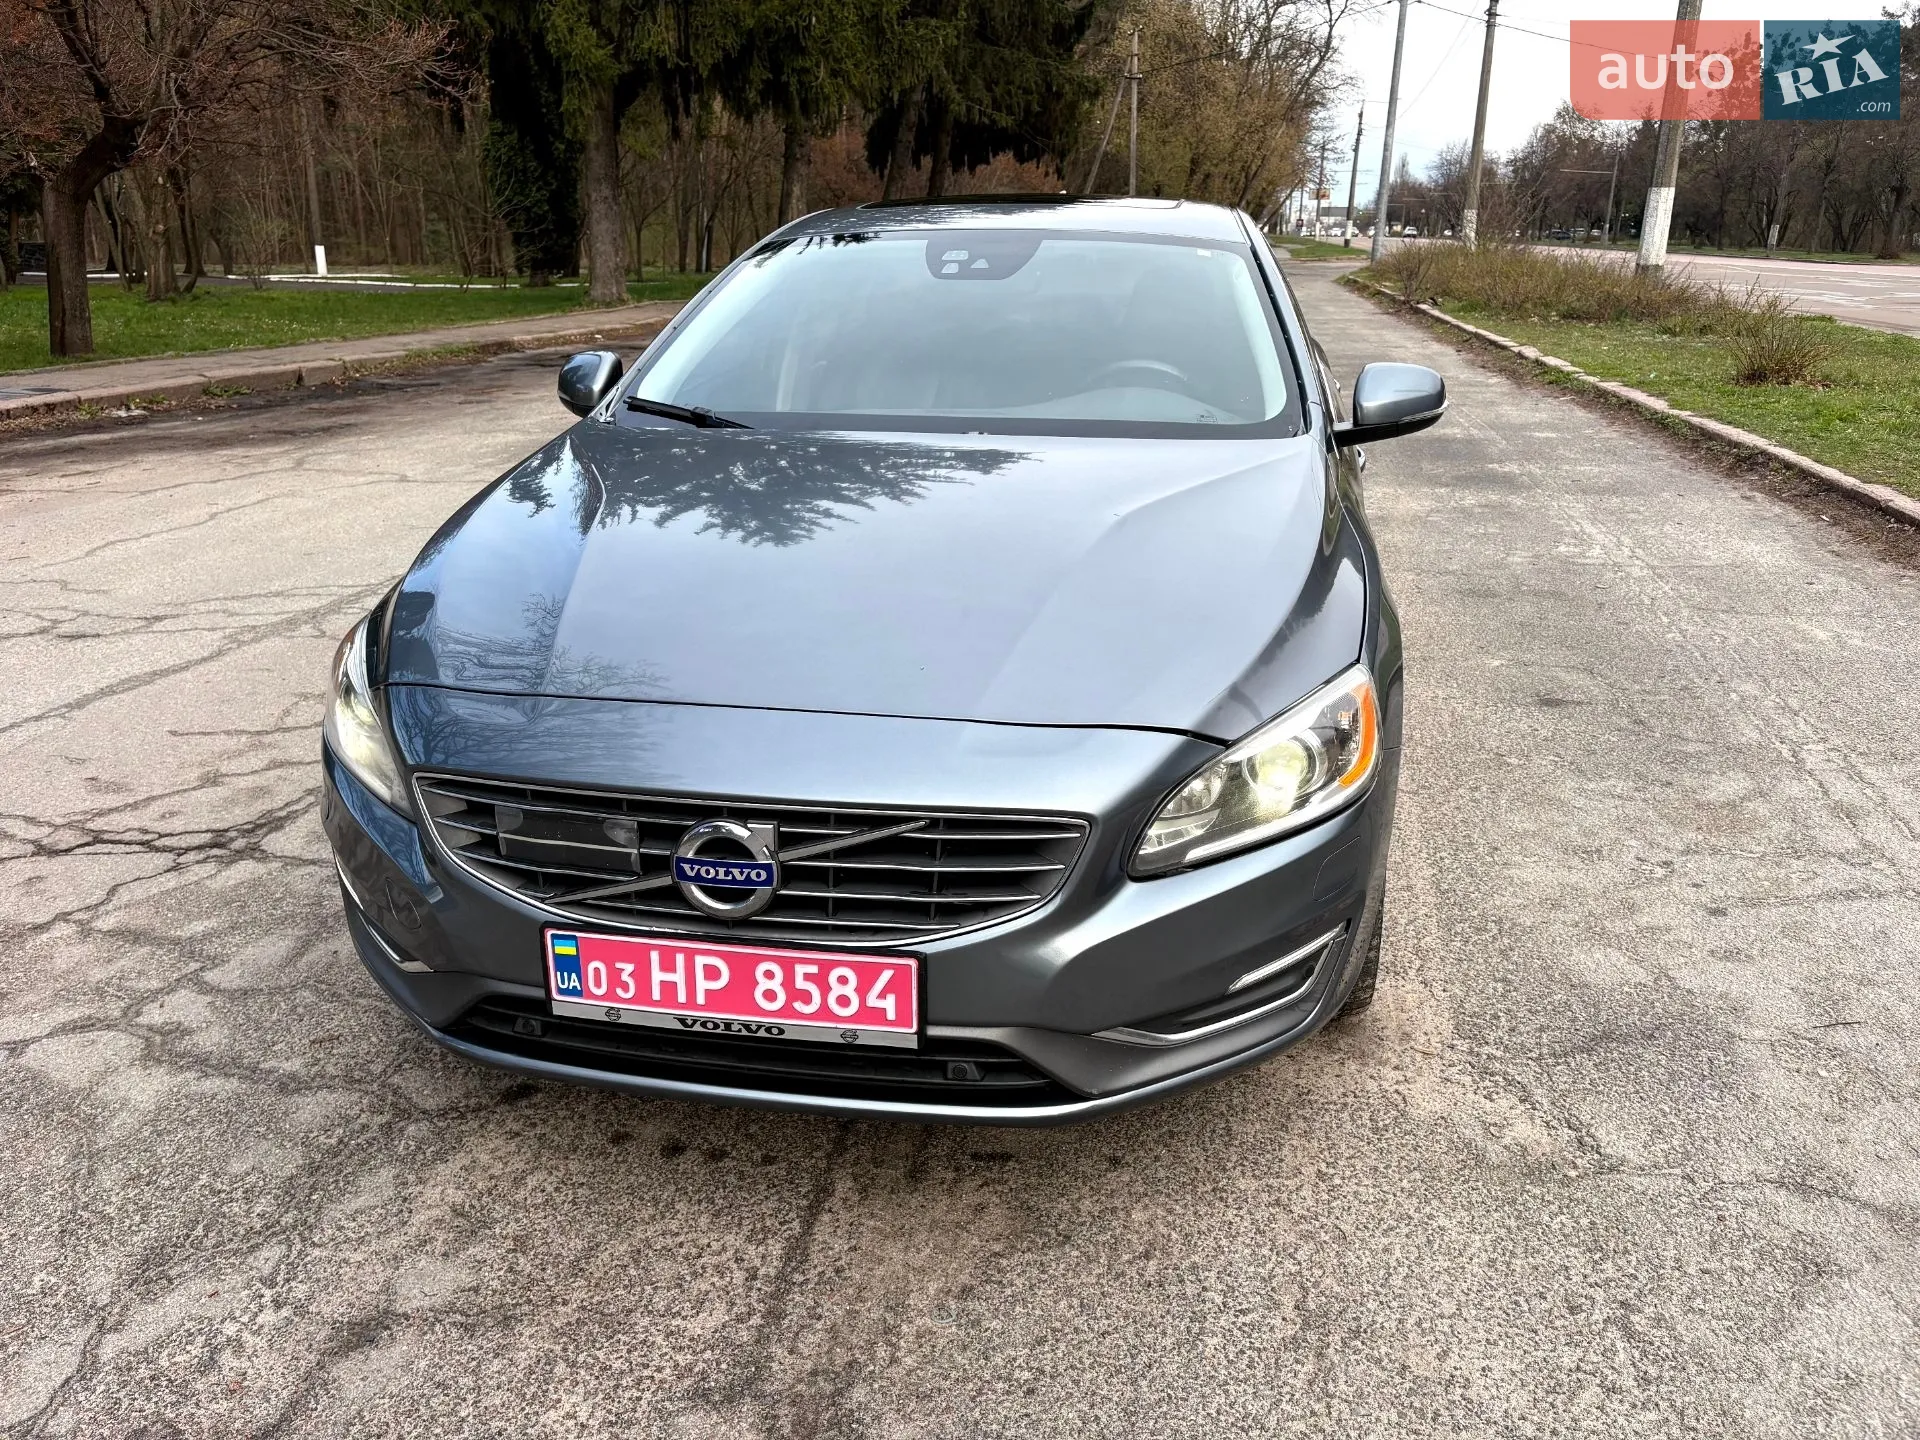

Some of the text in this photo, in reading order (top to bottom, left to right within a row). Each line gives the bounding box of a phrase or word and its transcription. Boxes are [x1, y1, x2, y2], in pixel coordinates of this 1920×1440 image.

[680, 863, 768, 882] VOLVO
[556, 971, 581, 991] UA
[587, 950, 897, 1022] 03 HP 8584
[673, 1016, 787, 1037] VOLVO
